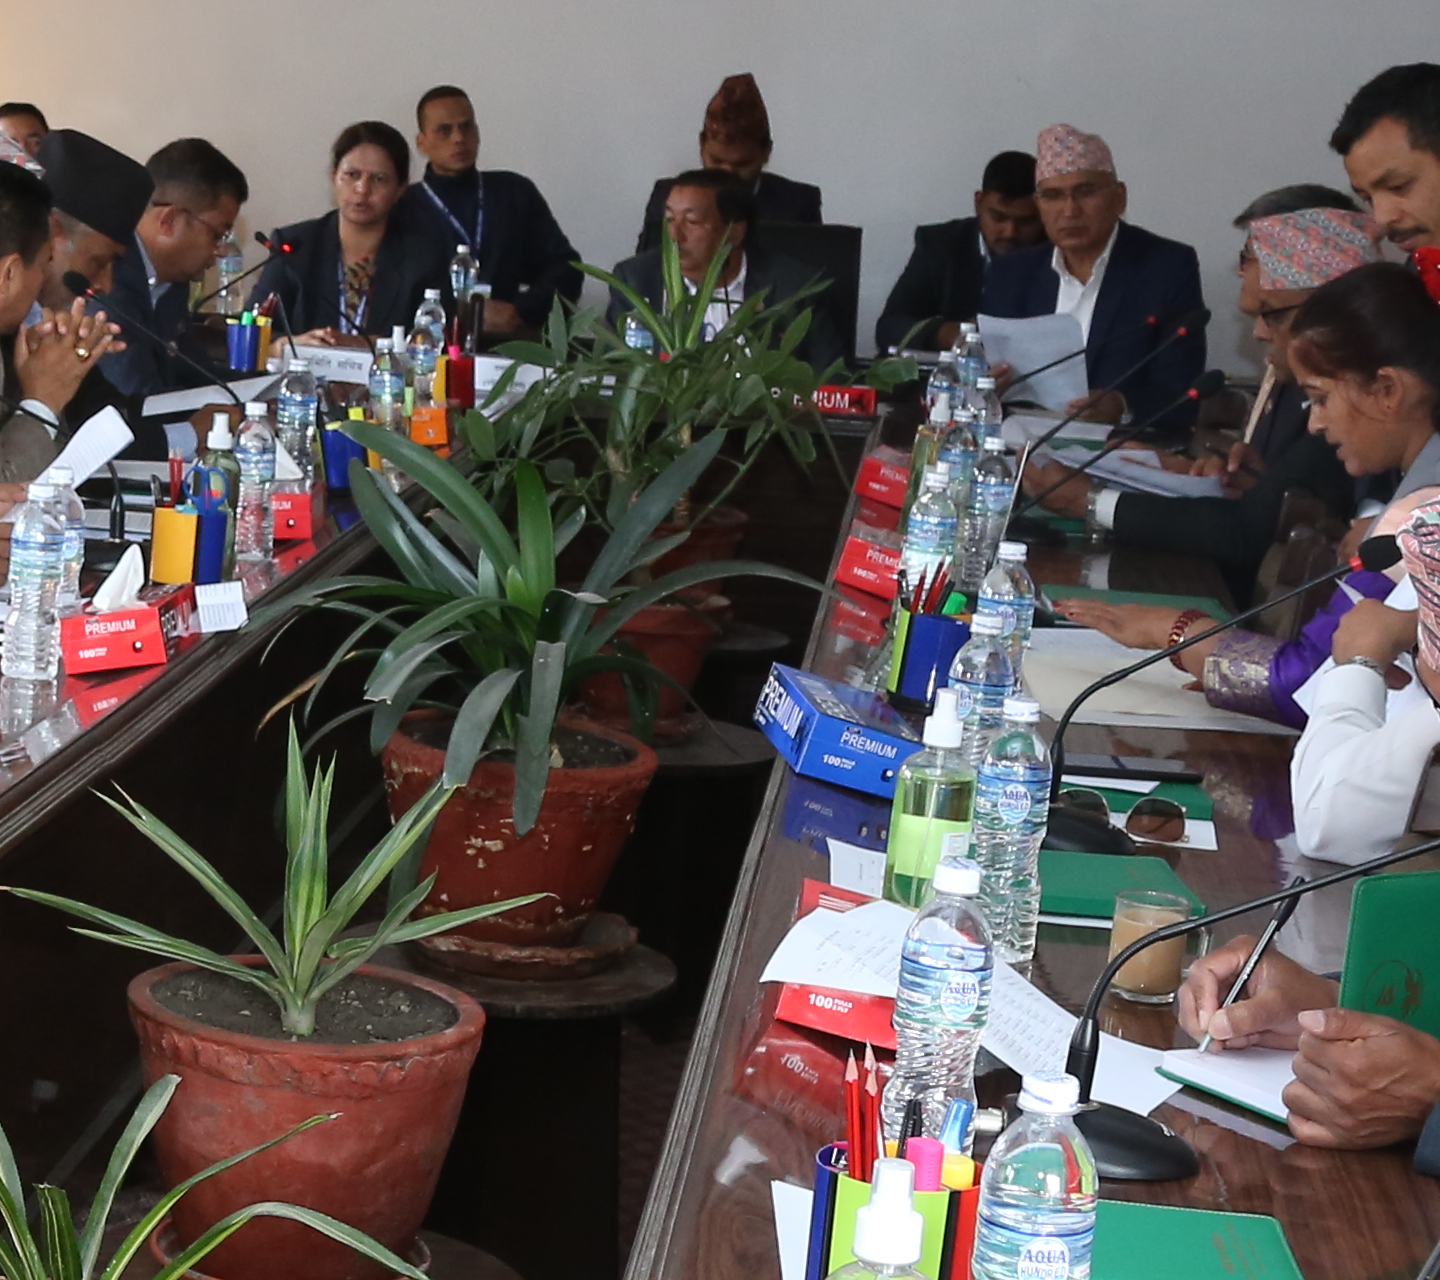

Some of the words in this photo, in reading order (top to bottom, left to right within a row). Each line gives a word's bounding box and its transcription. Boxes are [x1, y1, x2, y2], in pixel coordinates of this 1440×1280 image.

[85, 619, 136, 635] PREMIUM
[762, 675, 804, 739] PREMIUM
[840, 731, 898, 759] PREMIUM
[823, 754, 841, 767] 100
[944, 981, 977, 997] AQUA
[808, 993, 833, 1010] 100
[1022, 1248, 1067, 1266] AQUA
[1020, 1265, 1066, 1280] HUNDRED
